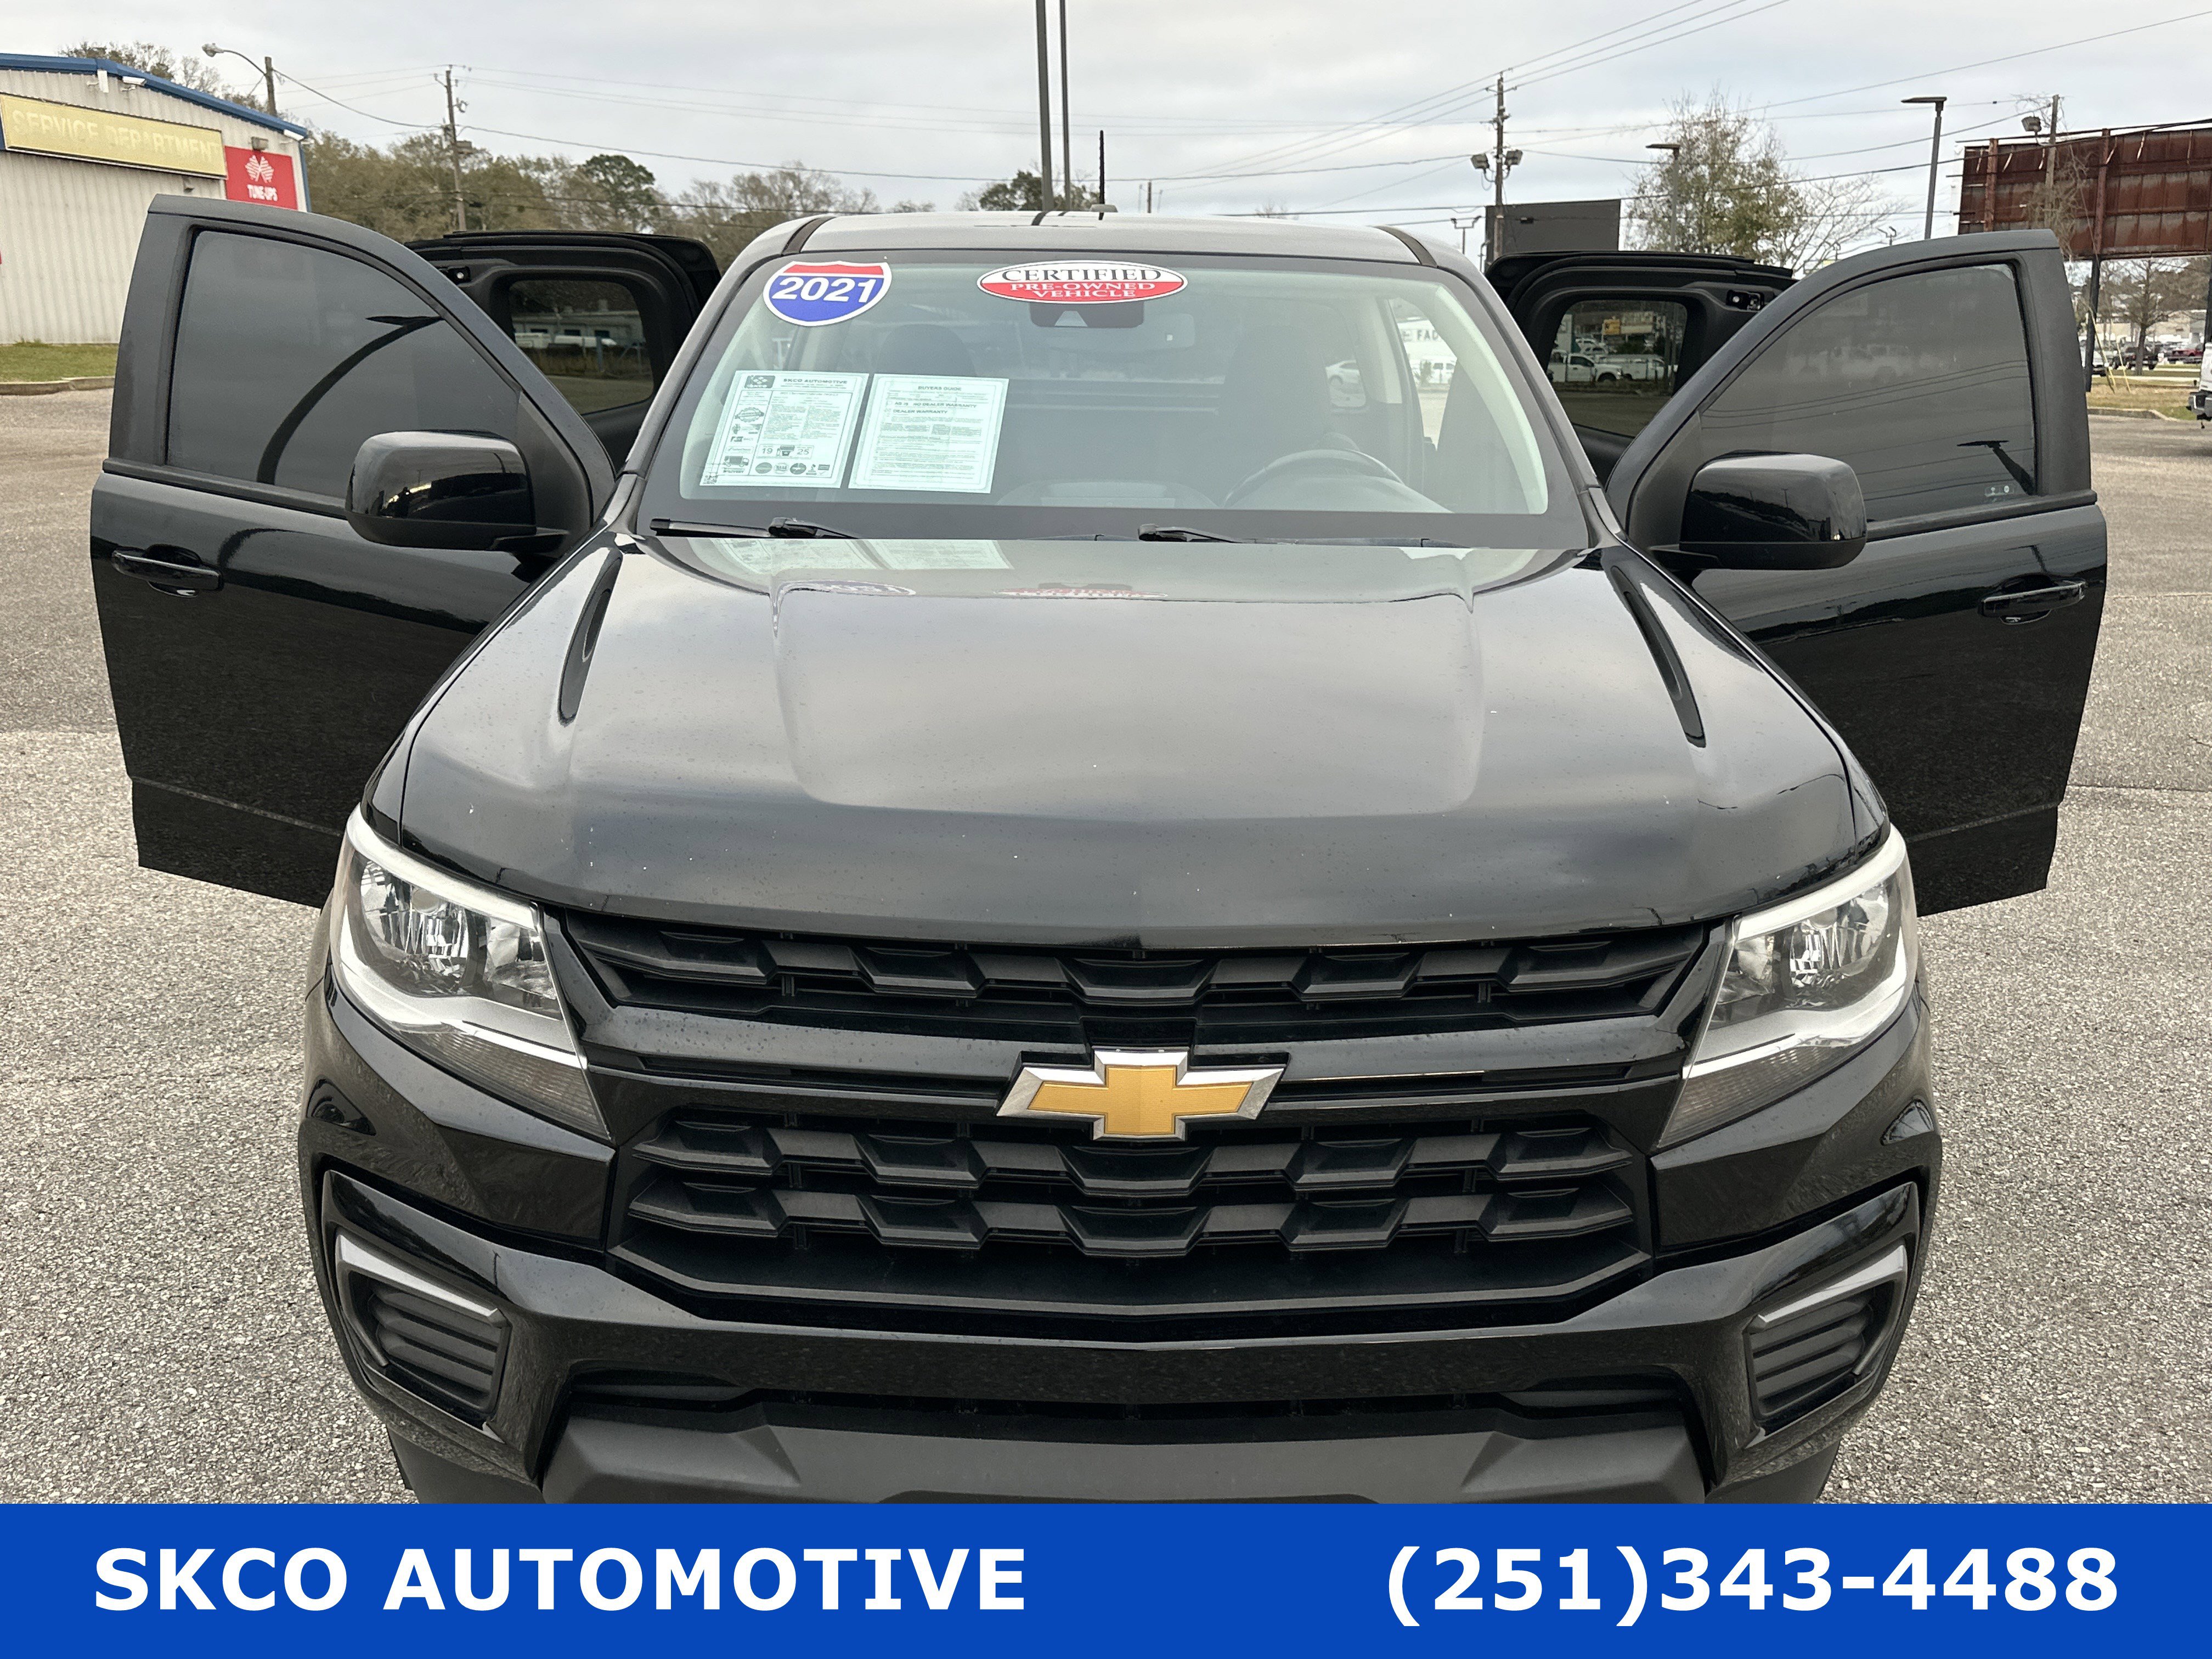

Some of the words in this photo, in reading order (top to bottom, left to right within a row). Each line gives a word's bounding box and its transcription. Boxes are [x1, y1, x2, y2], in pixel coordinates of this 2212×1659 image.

[12, 110, 98, 140] SERVICE
[106, 125, 220, 162] DEPARTMENT
[1002, 269, 1161, 281] CERTIFIED
[771, 276, 877, 303] 2021
[1010, 283, 1156, 291] PRE-OWNED
[1032, 290, 1137, 298] VEHICLE
